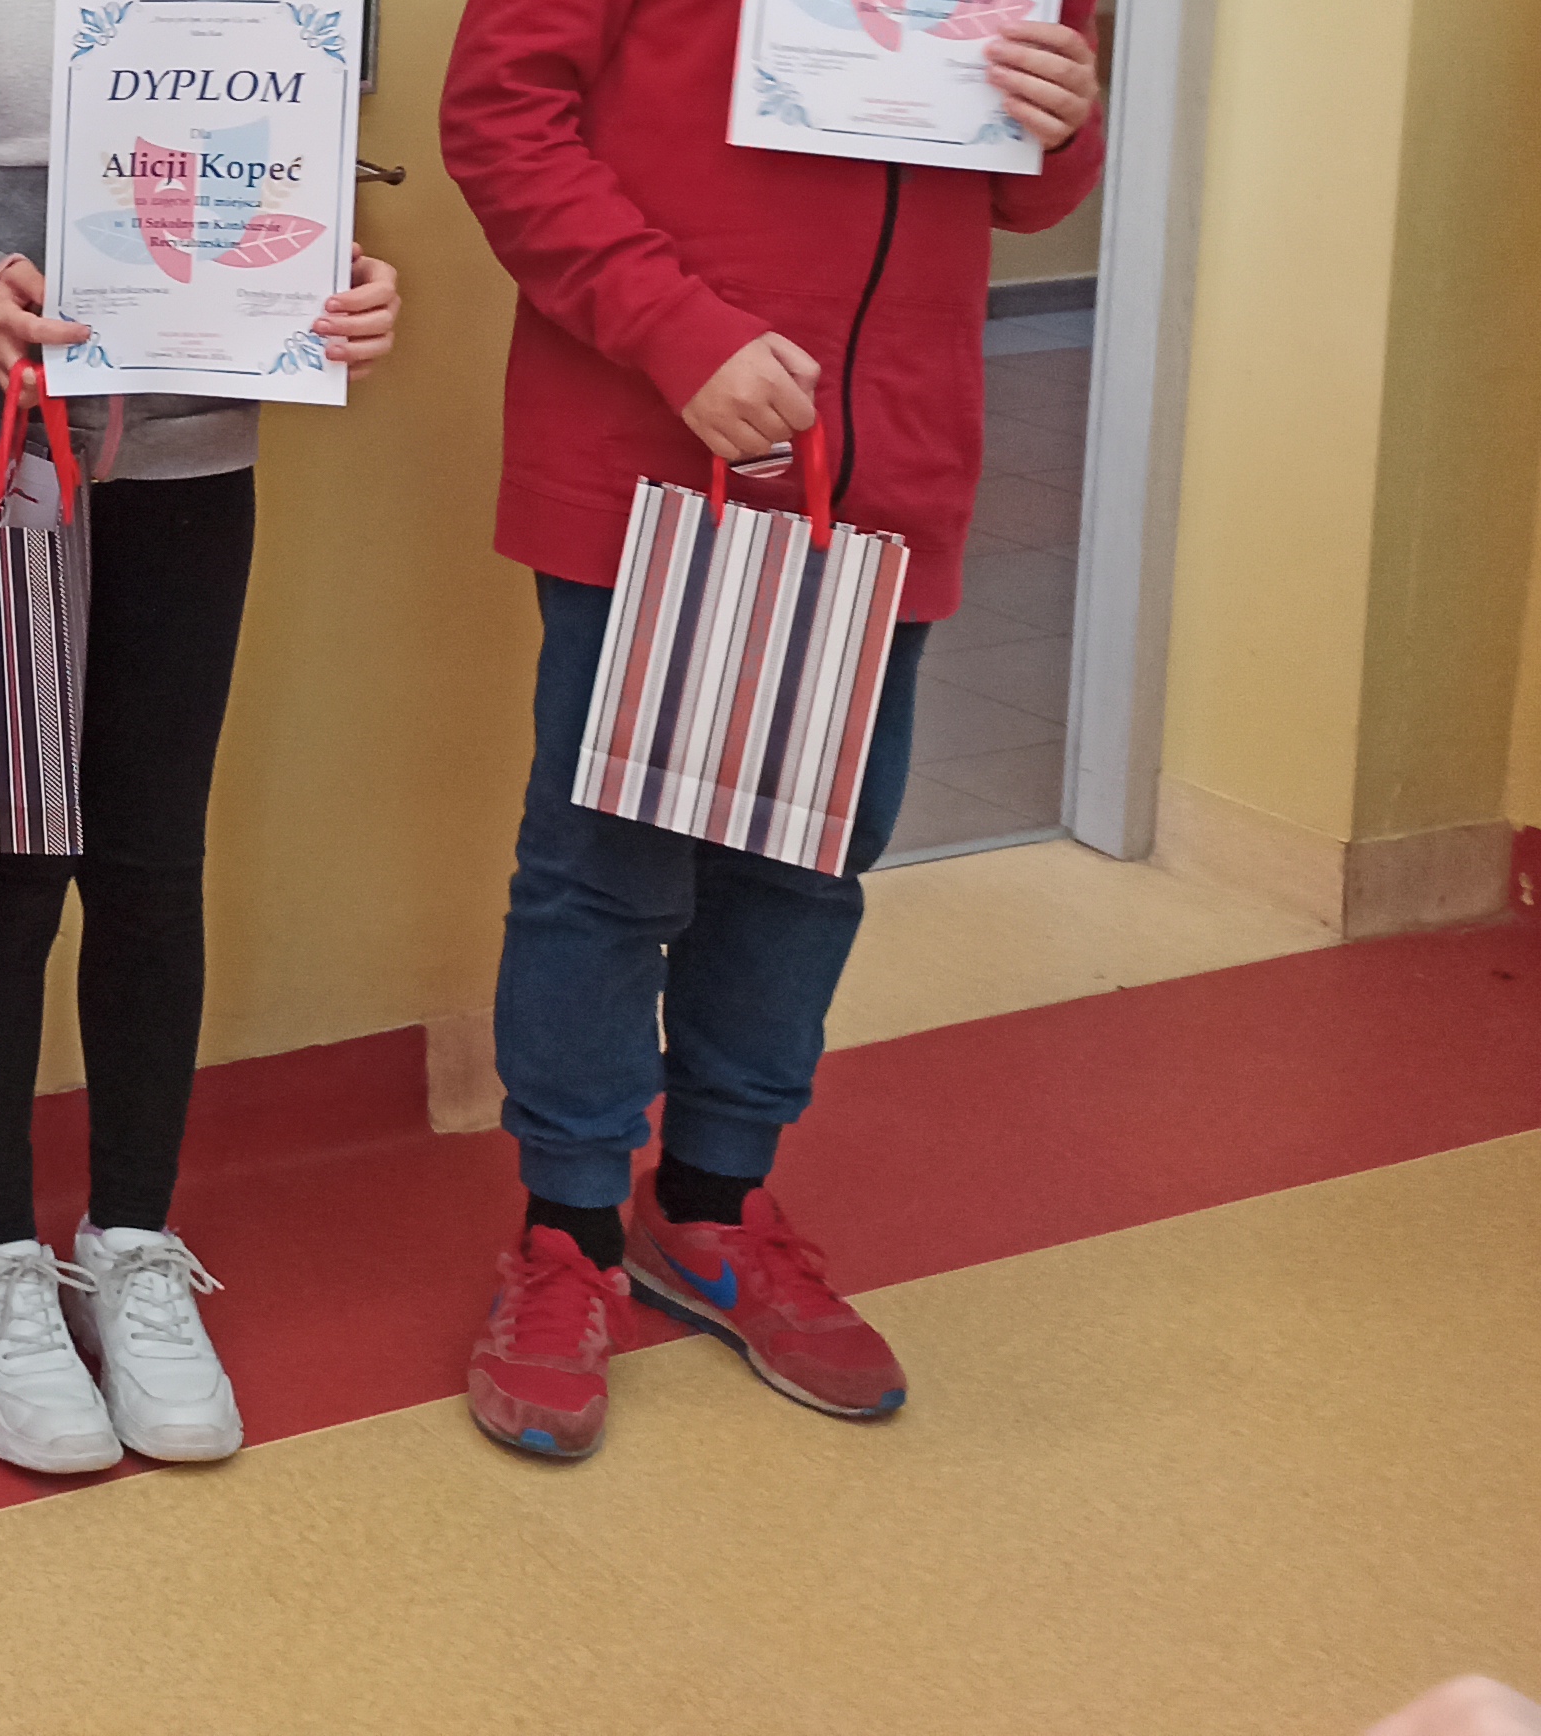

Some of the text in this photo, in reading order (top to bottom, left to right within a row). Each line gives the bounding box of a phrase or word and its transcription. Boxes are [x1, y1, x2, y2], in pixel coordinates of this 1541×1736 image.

[107, 69, 306, 103] DYPLOM
[102, 152, 302, 188] Alicji Kopeć
